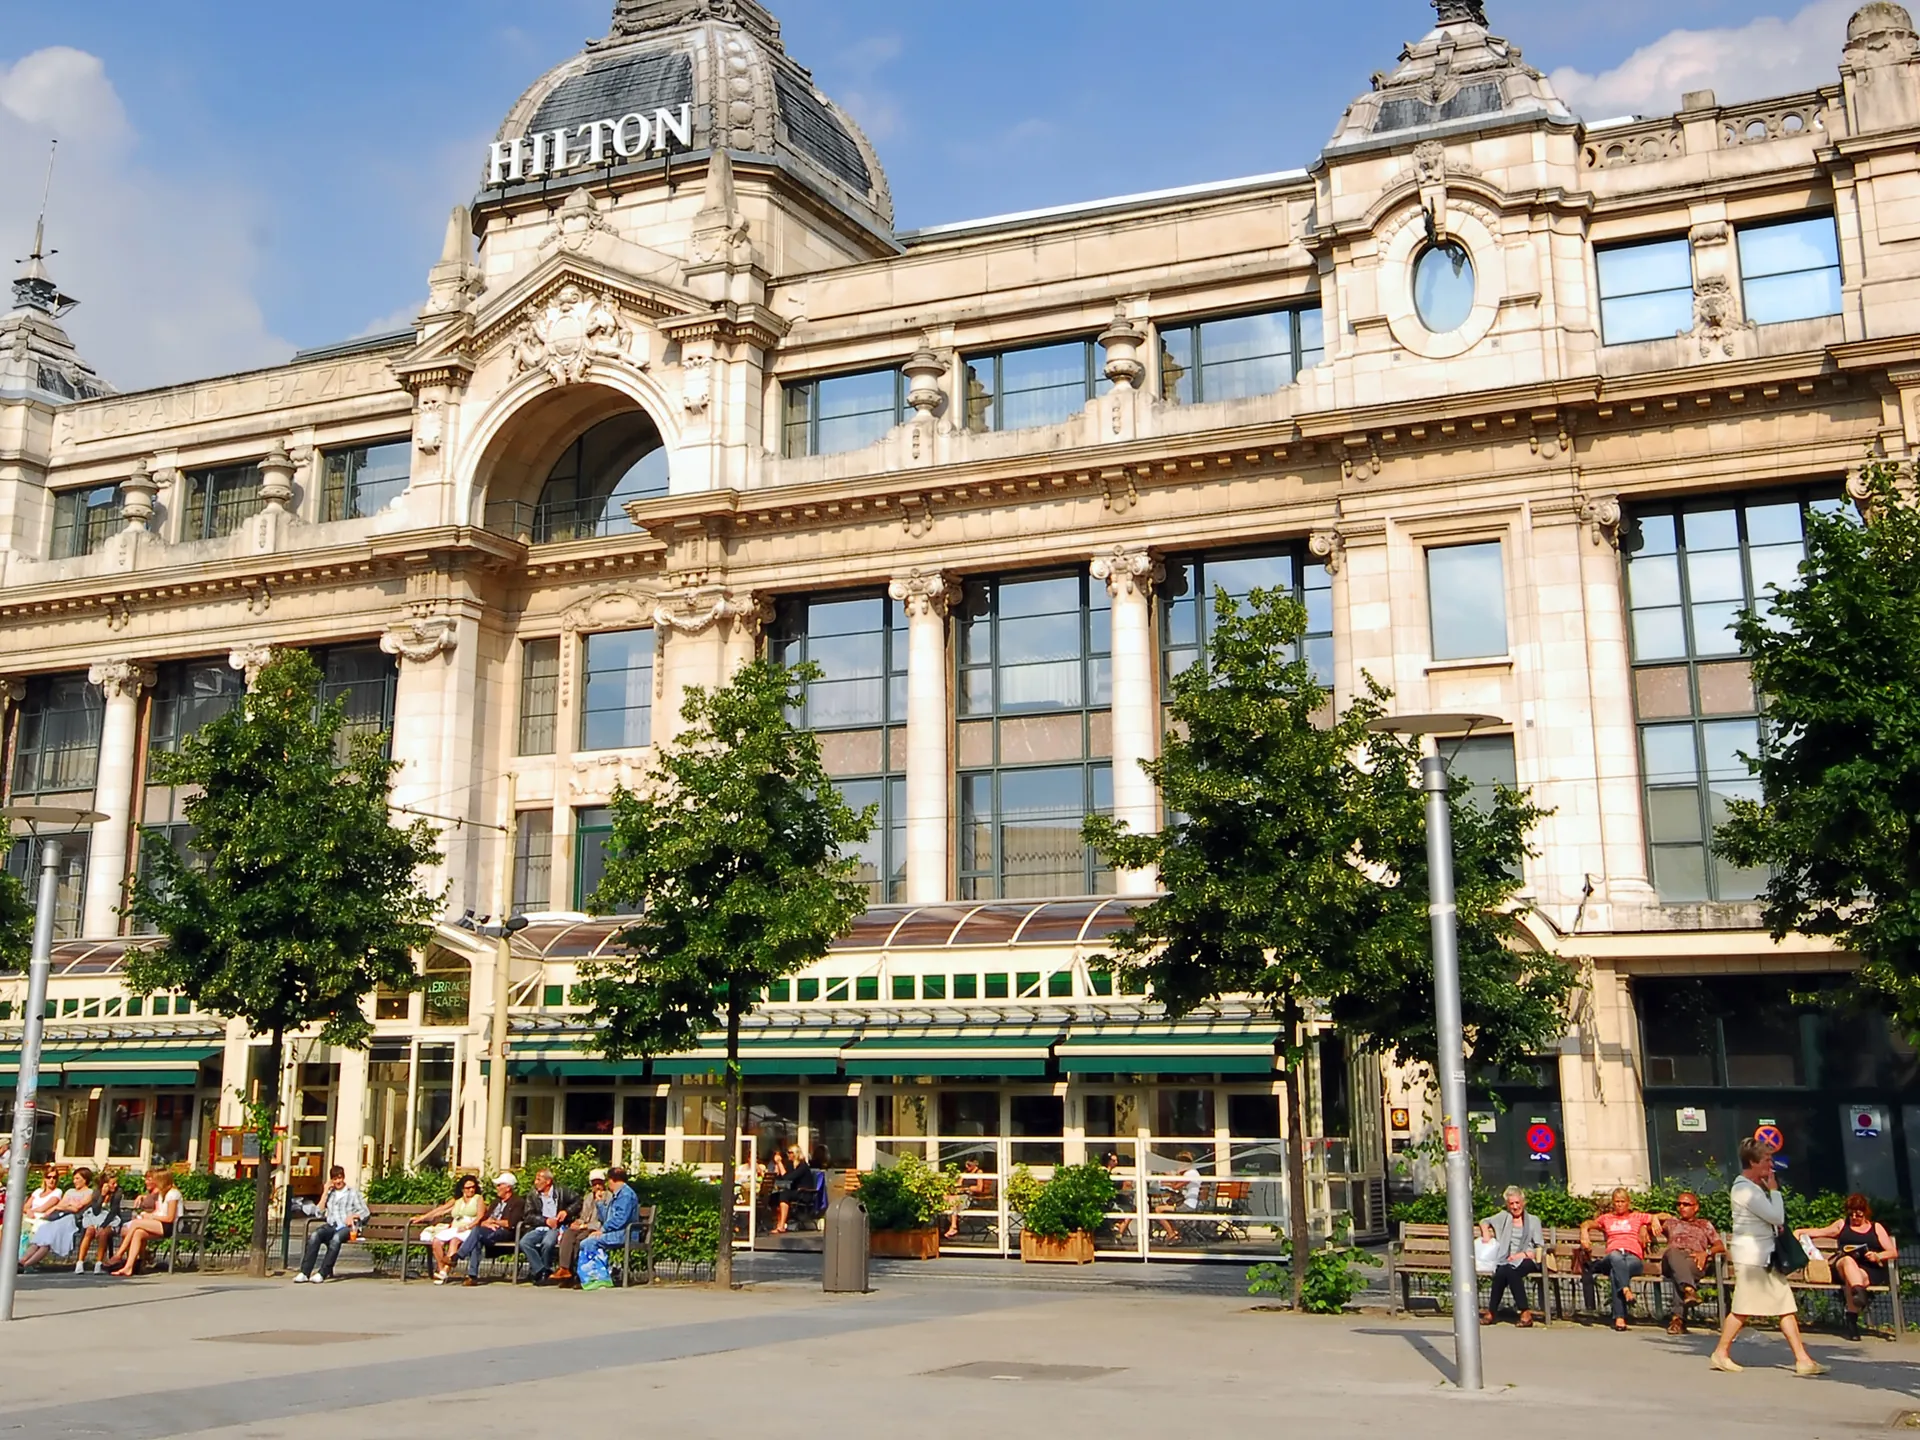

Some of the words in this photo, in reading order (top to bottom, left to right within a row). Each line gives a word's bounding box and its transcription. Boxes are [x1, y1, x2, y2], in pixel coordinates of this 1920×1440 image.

[487, 101, 695, 186] HILTON
[102, 389, 224, 434] GRAND
[265, 361, 388, 407] BAZAR
